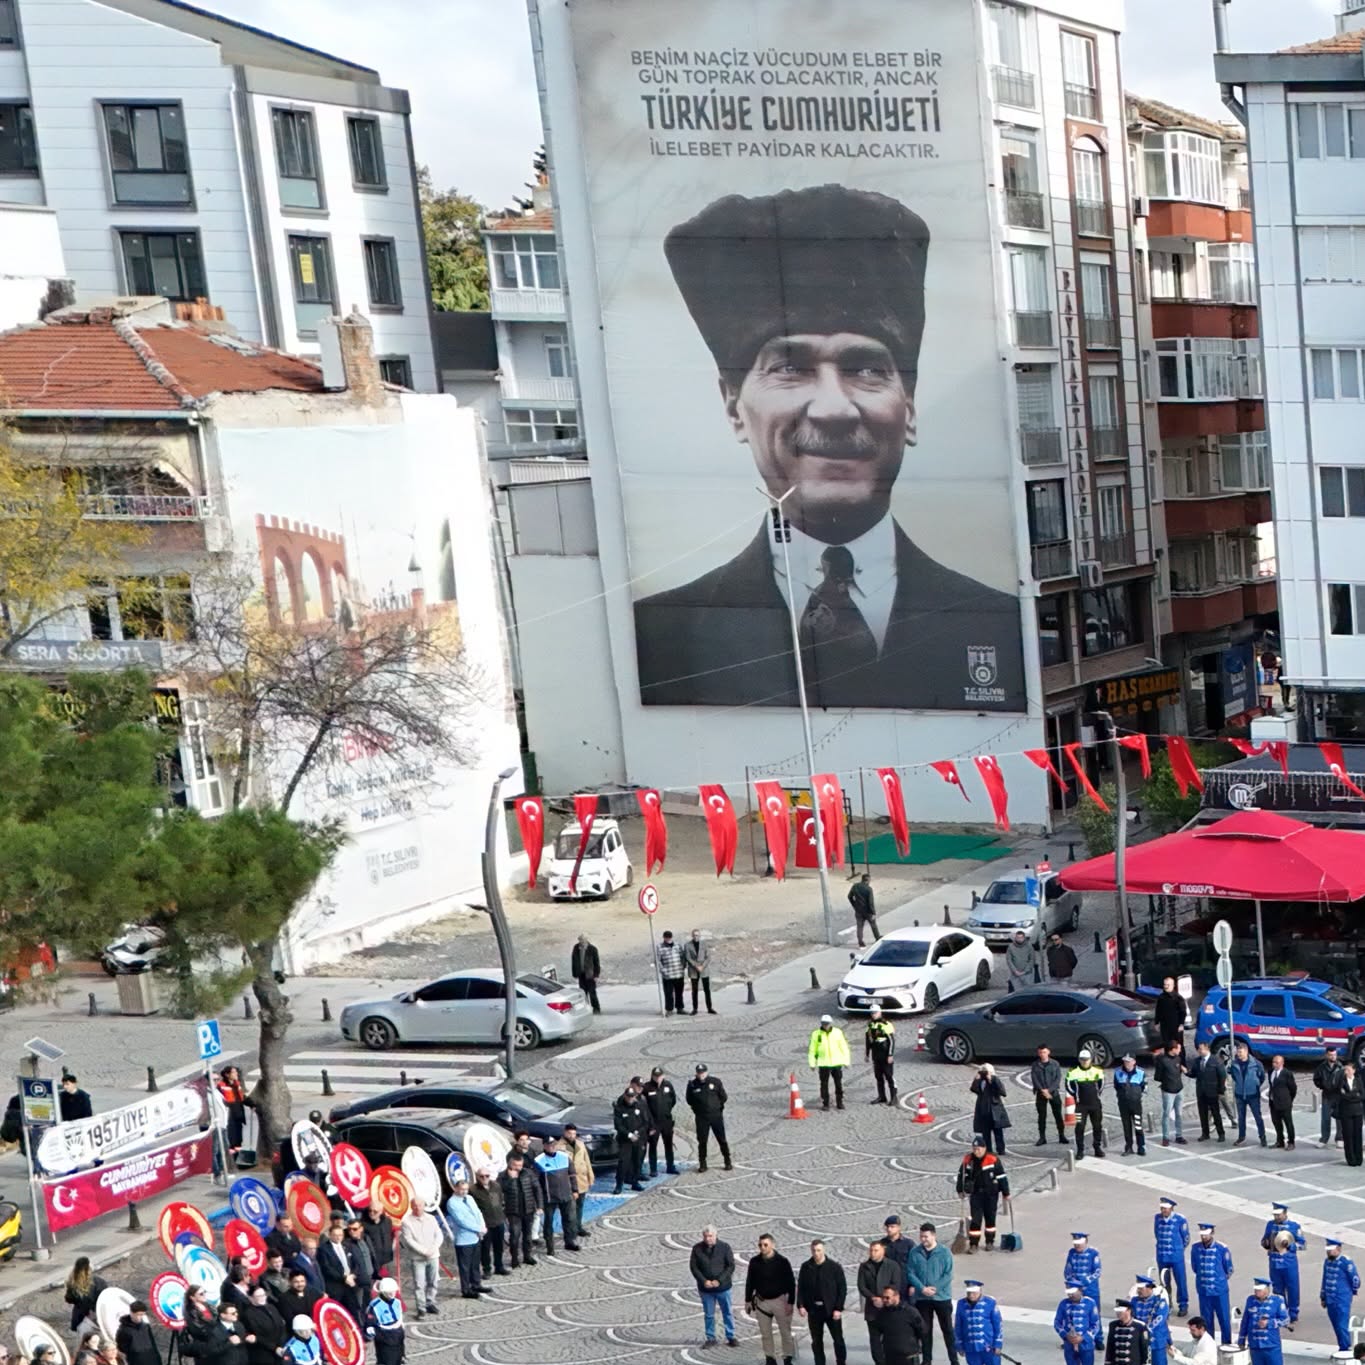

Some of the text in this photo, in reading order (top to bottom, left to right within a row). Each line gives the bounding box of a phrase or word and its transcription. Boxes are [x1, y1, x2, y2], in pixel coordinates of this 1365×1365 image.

[631, 48, 942, 68] BENİM NAÇİZ VÜCUDUM ELBET BİR
[638, 65, 938, 88] GÜN TOPRAK OLACAKTIR, ANCAK
[641, 88, 941, 132] TÜRKİYE CUMHURİYETİ
[650, 137, 940, 159] İLELEBET PAYİDAR KALACAKTIR.
[18, 645, 61, 661] SERA
[1258, 1025, 1291, 1035] JANDARMA
[87, 1117, 120, 1150] 1957
